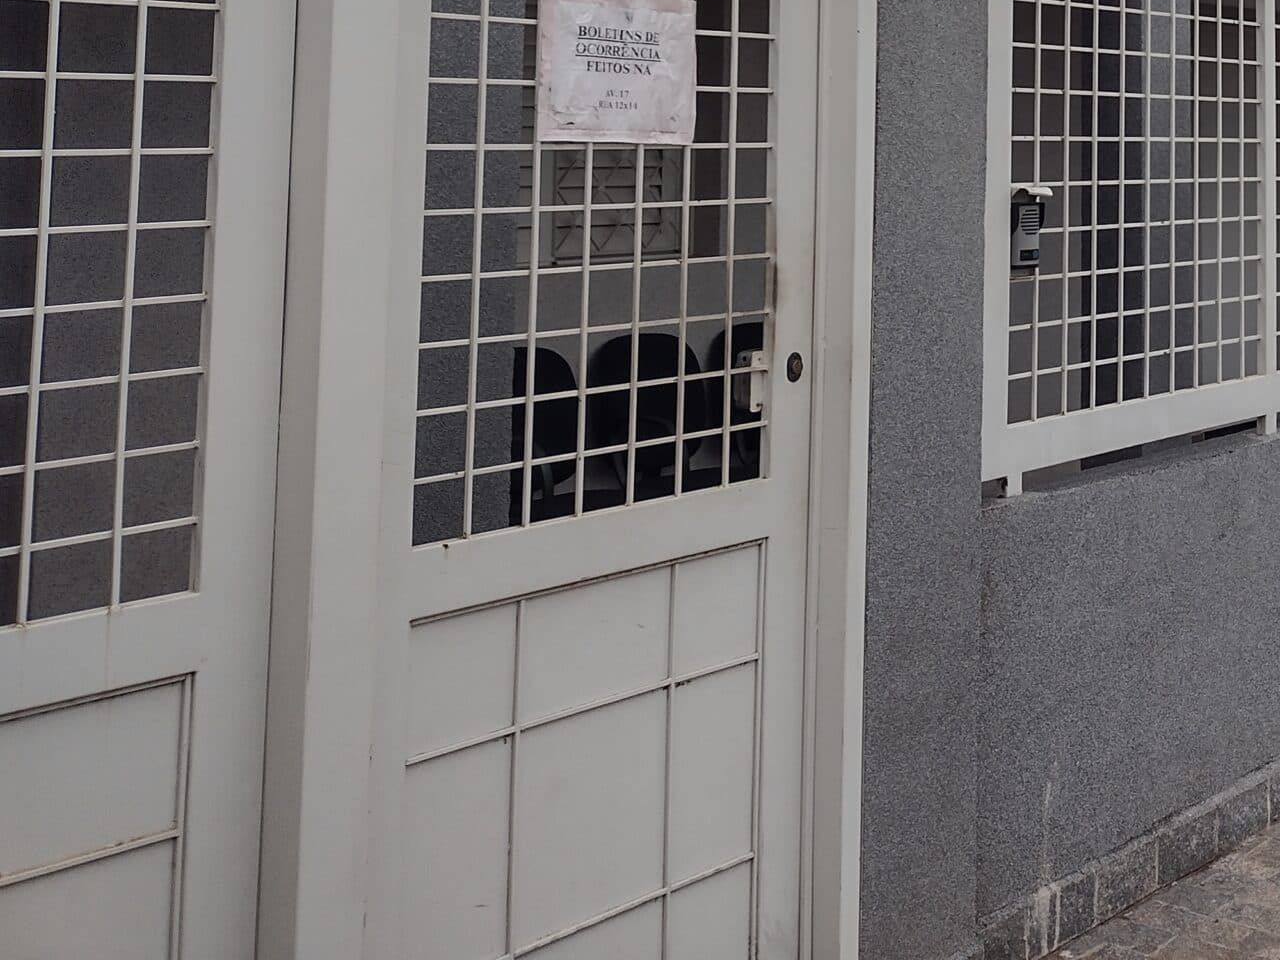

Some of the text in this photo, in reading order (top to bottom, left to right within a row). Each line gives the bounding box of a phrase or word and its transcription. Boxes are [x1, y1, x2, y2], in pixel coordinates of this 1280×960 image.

[578, 25, 660, 43] BOLETINS DE
[576, 42, 661, 59] OCORRÊNCIA
[587, 60, 652, 75] FEITOS NA
